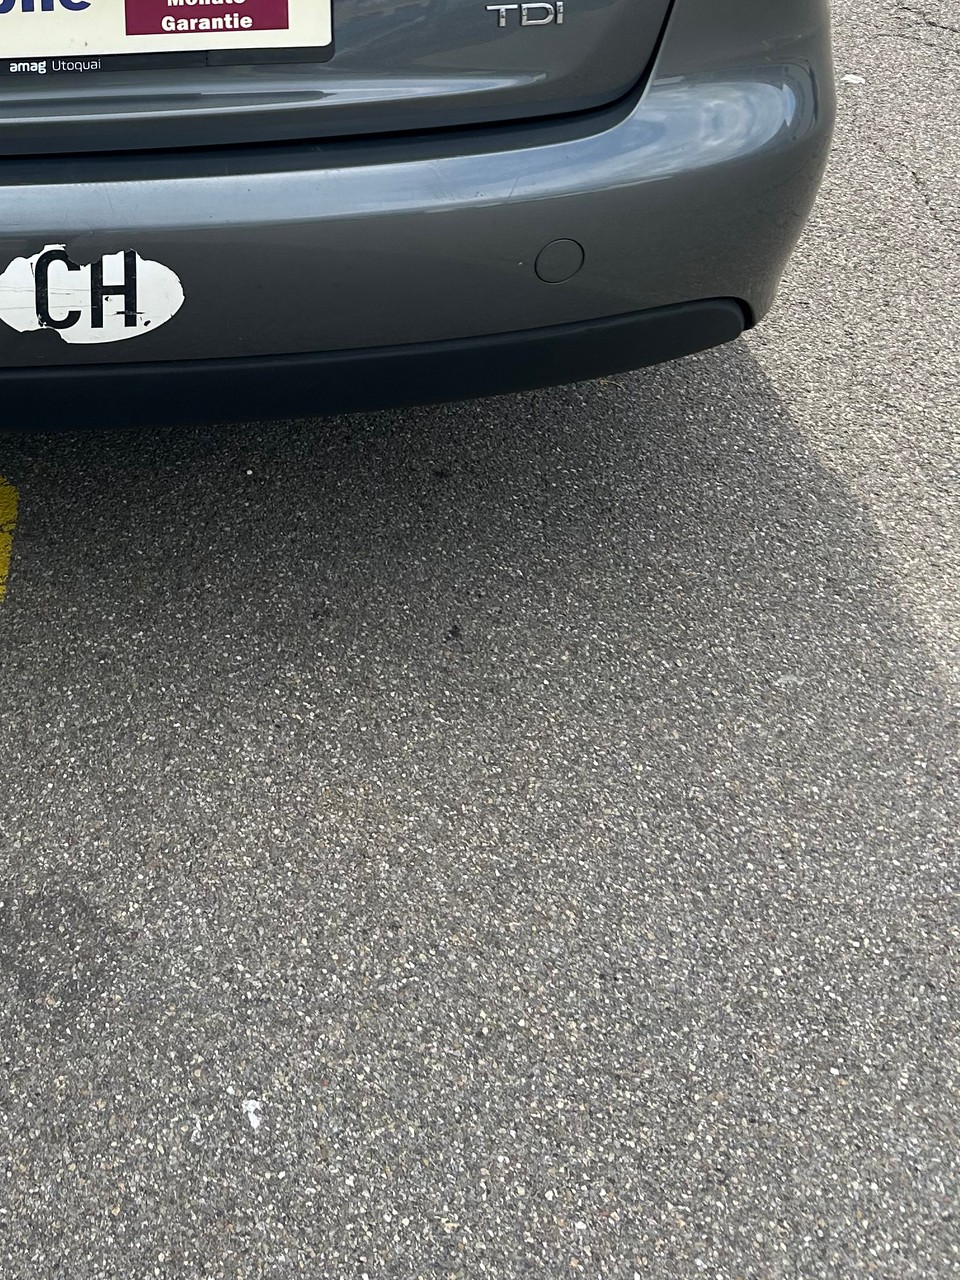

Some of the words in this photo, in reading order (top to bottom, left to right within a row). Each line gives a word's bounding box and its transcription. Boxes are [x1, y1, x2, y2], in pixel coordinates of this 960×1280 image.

[161, 12, 253, 32] Garantie
[485, 1, 564, 27] TDI
[9, 60, 47, 75] amag
[51, 58, 101, 73] Utoquai
[34, 248, 138, 329] CH
